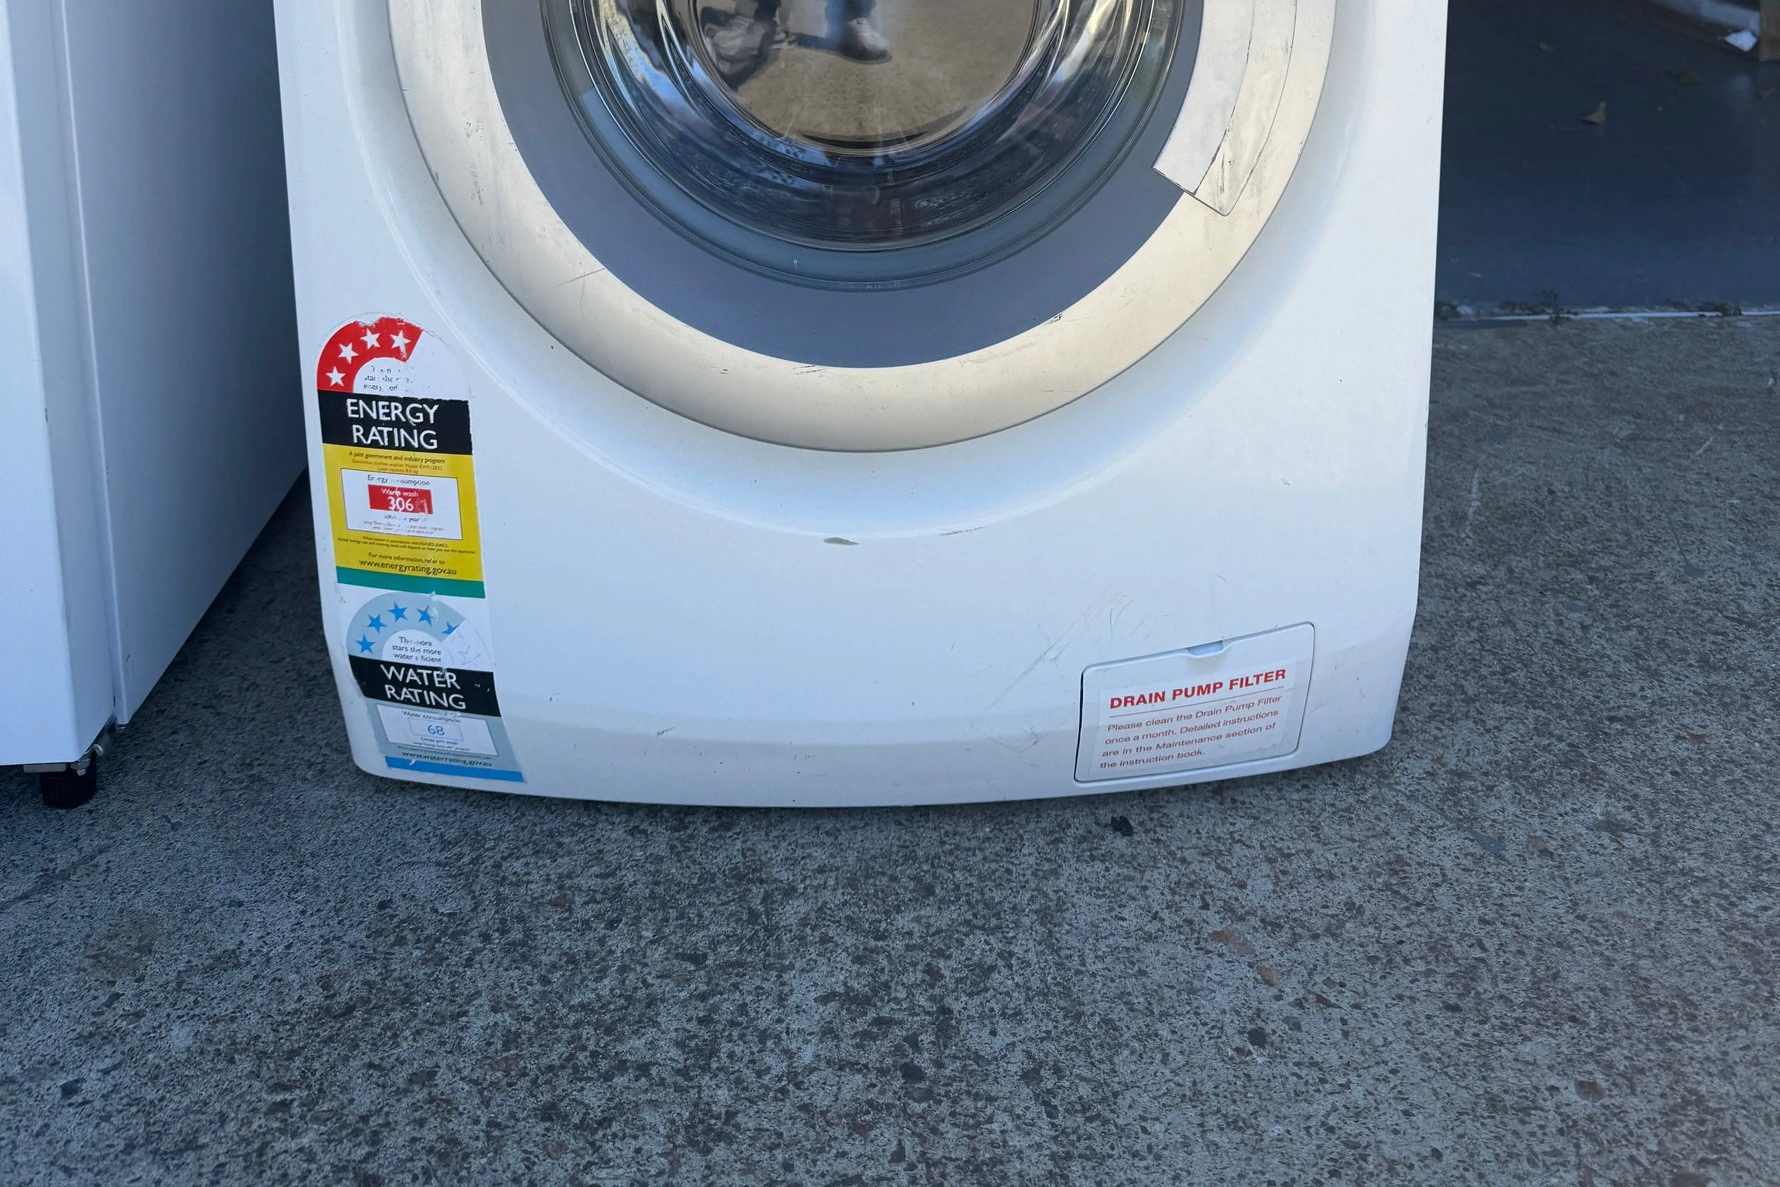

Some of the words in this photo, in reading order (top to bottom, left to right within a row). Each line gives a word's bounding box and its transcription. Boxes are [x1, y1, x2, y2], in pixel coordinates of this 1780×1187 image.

[346, 398, 439, 425] ENERGY
[352, 424, 438, 450] RATING
[388, 496, 414, 512] 306
[403, 489, 418, 497] wash
[359, 559, 457, 575] www.energyrating.gov.au
[380, 663, 461, 689] WATER
[1109, 691, 1166, 710] DRAIN
[1172, 681, 1223, 701] PUMP
[1228, 668, 1286, 690] FILTER
[384, 684, 467, 710] RATING
[1107, 721, 1143, 732] Please
[1145, 716, 1173, 727] clean
[1176, 713, 1193, 723] the
[1195, 707, 1222, 719] Drain
[1225, 701, 1255, 715] Pump
[1257, 695, 1282, 707] Filter
[427, 724, 445, 736] 68
[1102, 749, 1119, 757] are
[1122, 746, 1133, 755] in
[1135, 744, 1152, 754] the
[1155, 734, 1223, 751] Maintenance
[1225, 726, 1263, 739] section
[1265, 722, 1277, 731] of
[1104, 736, 1131, 745] once
[1141, 729, 1177, 740] month.
[1180, 721, 1221, 734] Detailed
[1223, 709, 1279, 728] instructions
[1100, 761, 1117, 770] the
[1119, 754, 1174, 768] instruction
[1177, 749, 1206, 760] book.
